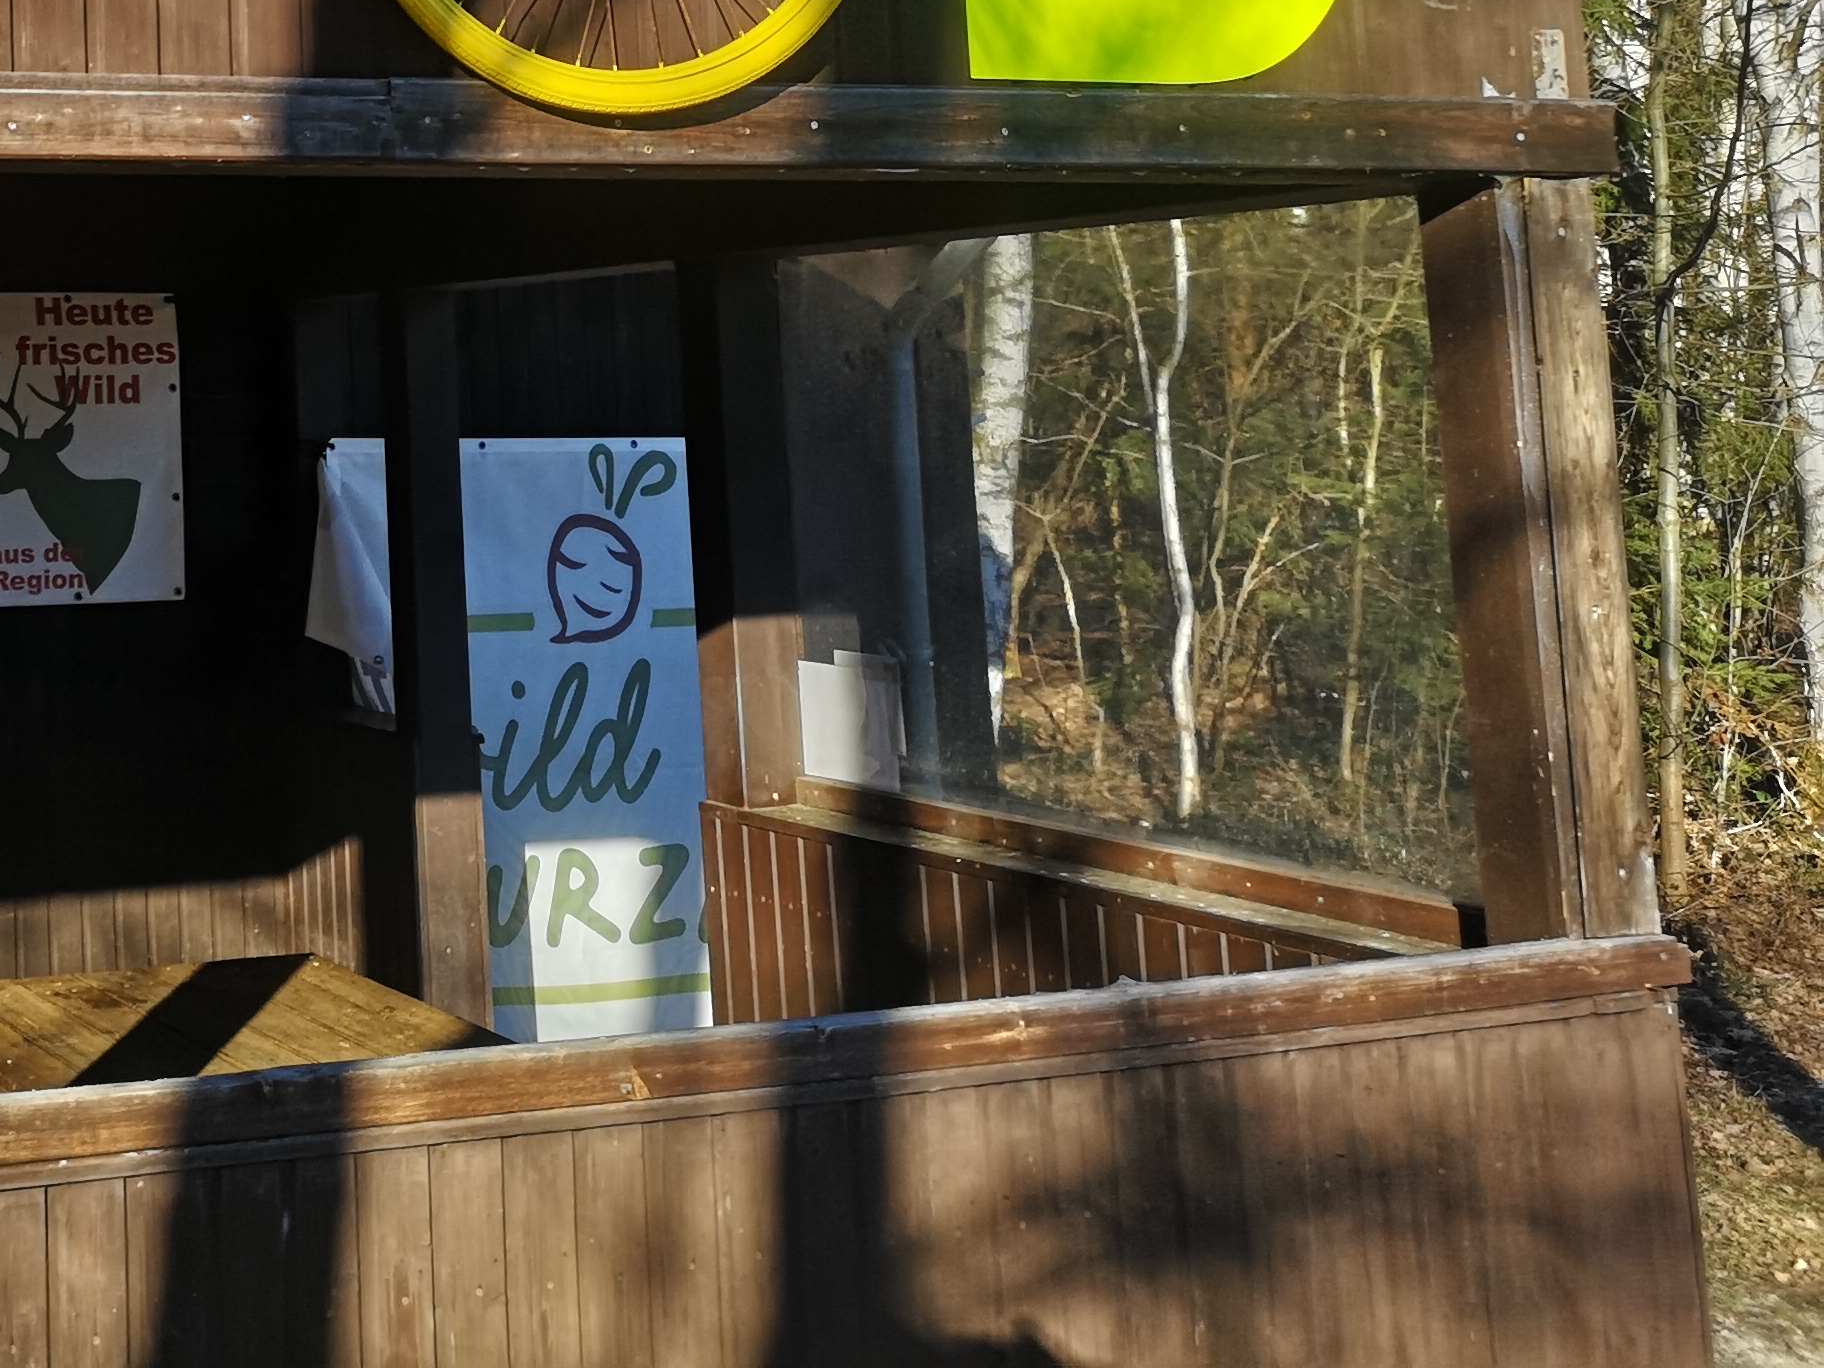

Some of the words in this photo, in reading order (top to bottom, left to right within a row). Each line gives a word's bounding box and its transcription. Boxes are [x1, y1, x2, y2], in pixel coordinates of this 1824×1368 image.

[34, 296, 154, 326] Heute
[15, 335, 177, 366] frisches
[54, 374, 141, 405] Wild
[43, 543, 83, 563] de
[479, 658, 661, 813] ild
